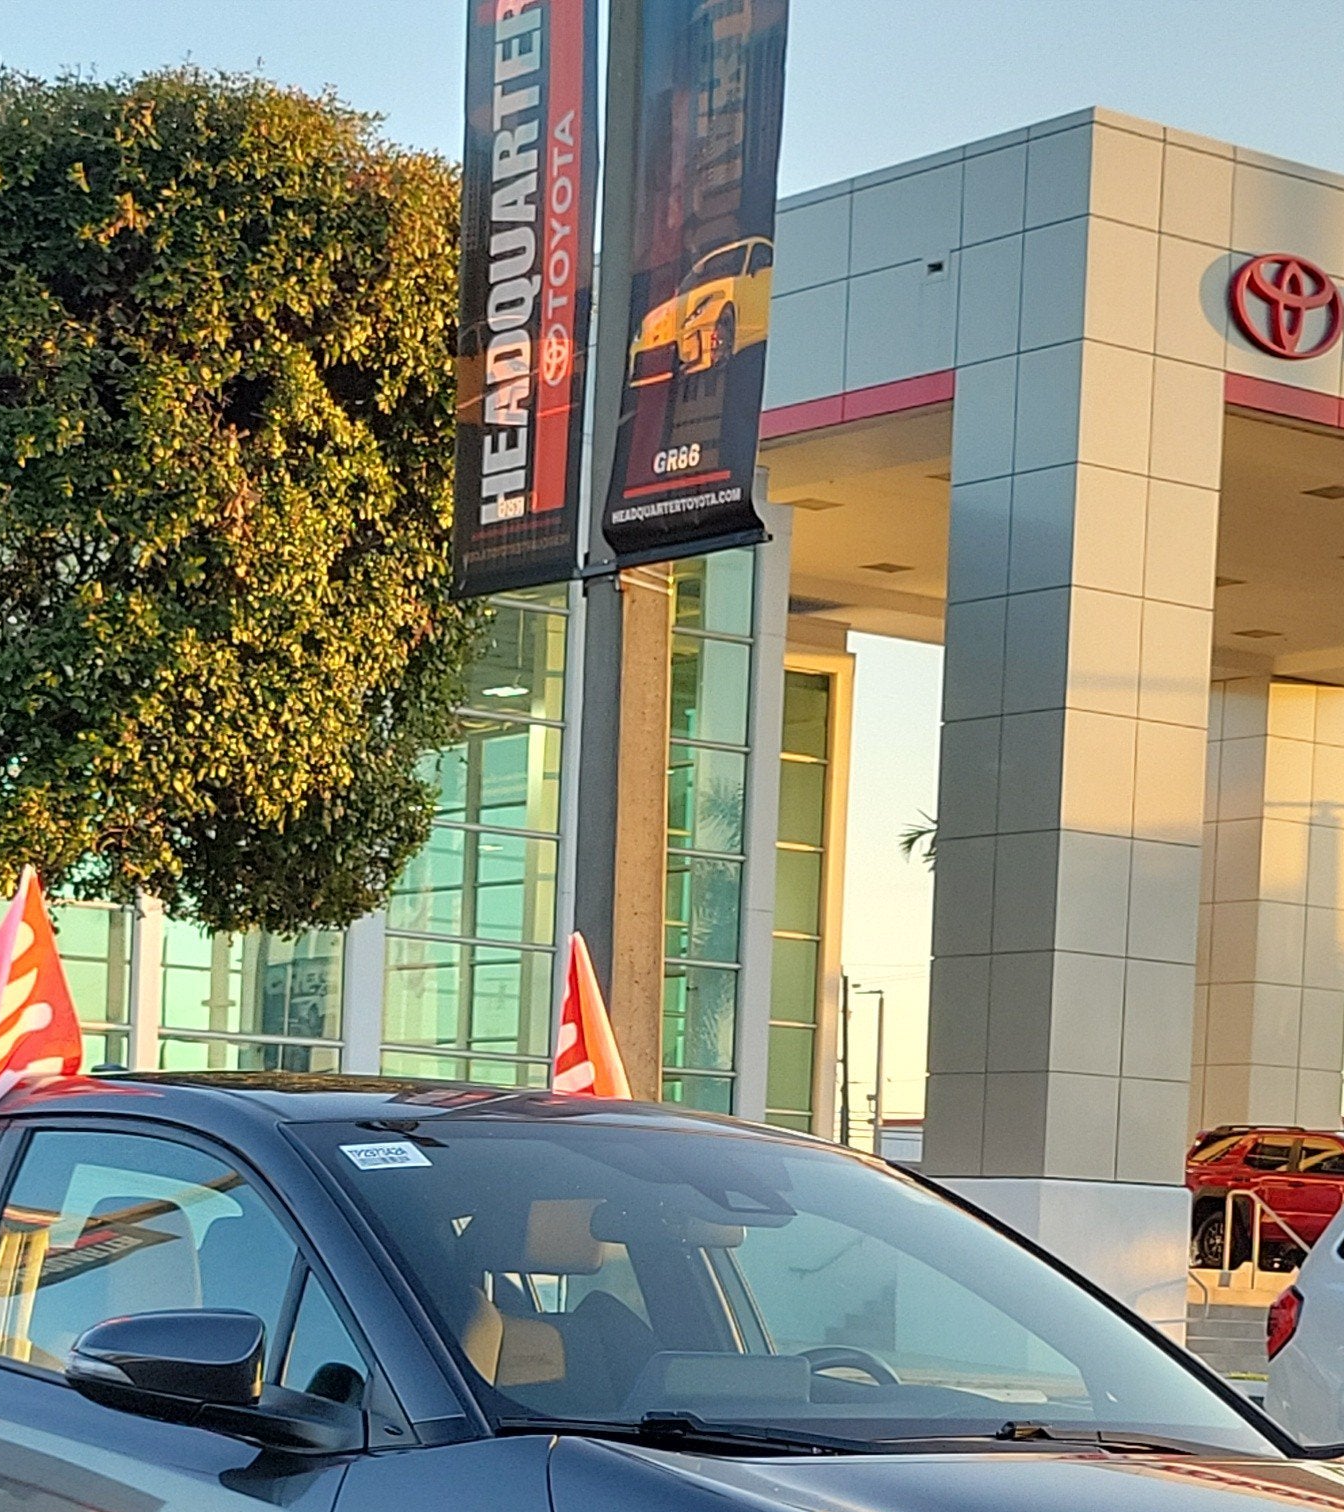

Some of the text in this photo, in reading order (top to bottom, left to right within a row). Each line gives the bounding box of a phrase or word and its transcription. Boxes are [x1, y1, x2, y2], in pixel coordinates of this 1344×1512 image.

[479, 0, 546, 525] HEADQUARTER
[546, 110, 577, 317] TOYOTA
[611, 487, 742, 524] HEADQUARTERTOYOTA.COM
[653, 443, 701, 474] GR86
